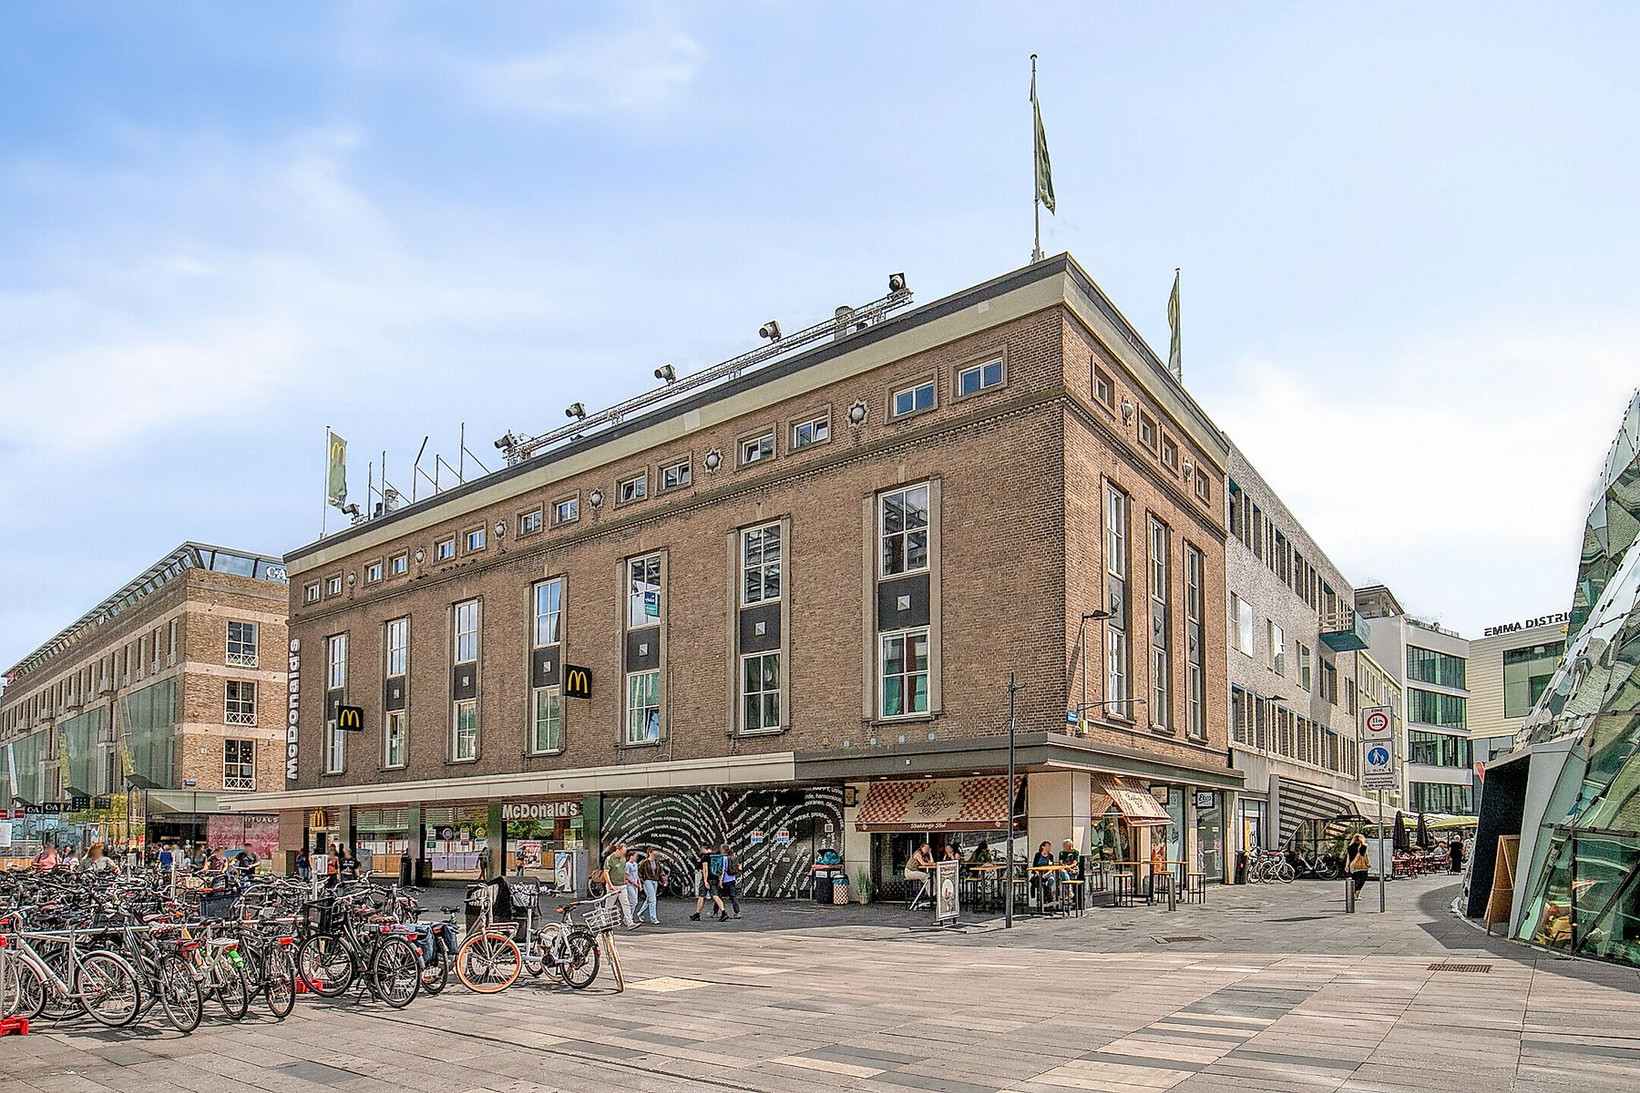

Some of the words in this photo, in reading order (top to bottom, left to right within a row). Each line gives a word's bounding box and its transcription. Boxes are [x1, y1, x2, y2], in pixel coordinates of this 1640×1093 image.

[1484, 621, 1522, 636] EMMA
[1525, 611, 1571, 629] DISTRI
[287, 638, 300, 780] McDonald's
[502, 802, 572, 819] McDonald's
